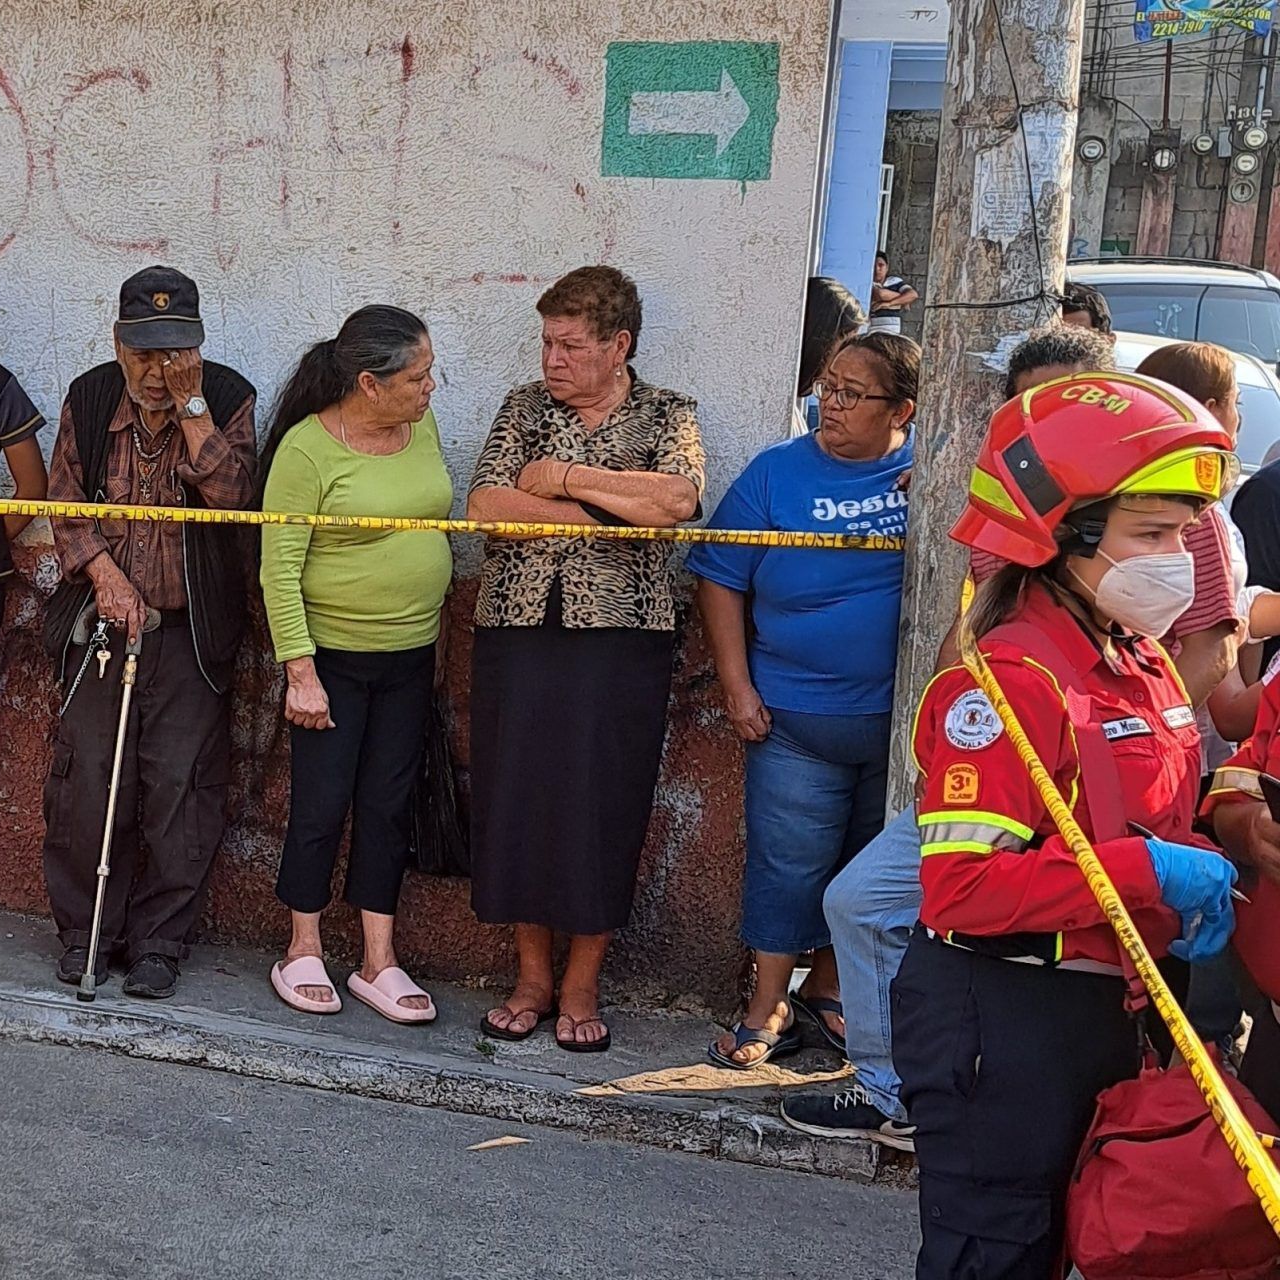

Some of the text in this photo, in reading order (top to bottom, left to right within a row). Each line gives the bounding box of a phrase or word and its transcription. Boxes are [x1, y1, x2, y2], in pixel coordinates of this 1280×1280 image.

[1061, 384, 1133, 416] CBM
[812, 483, 910, 521] Jesú
[846, 511, 905, 530] es mi
